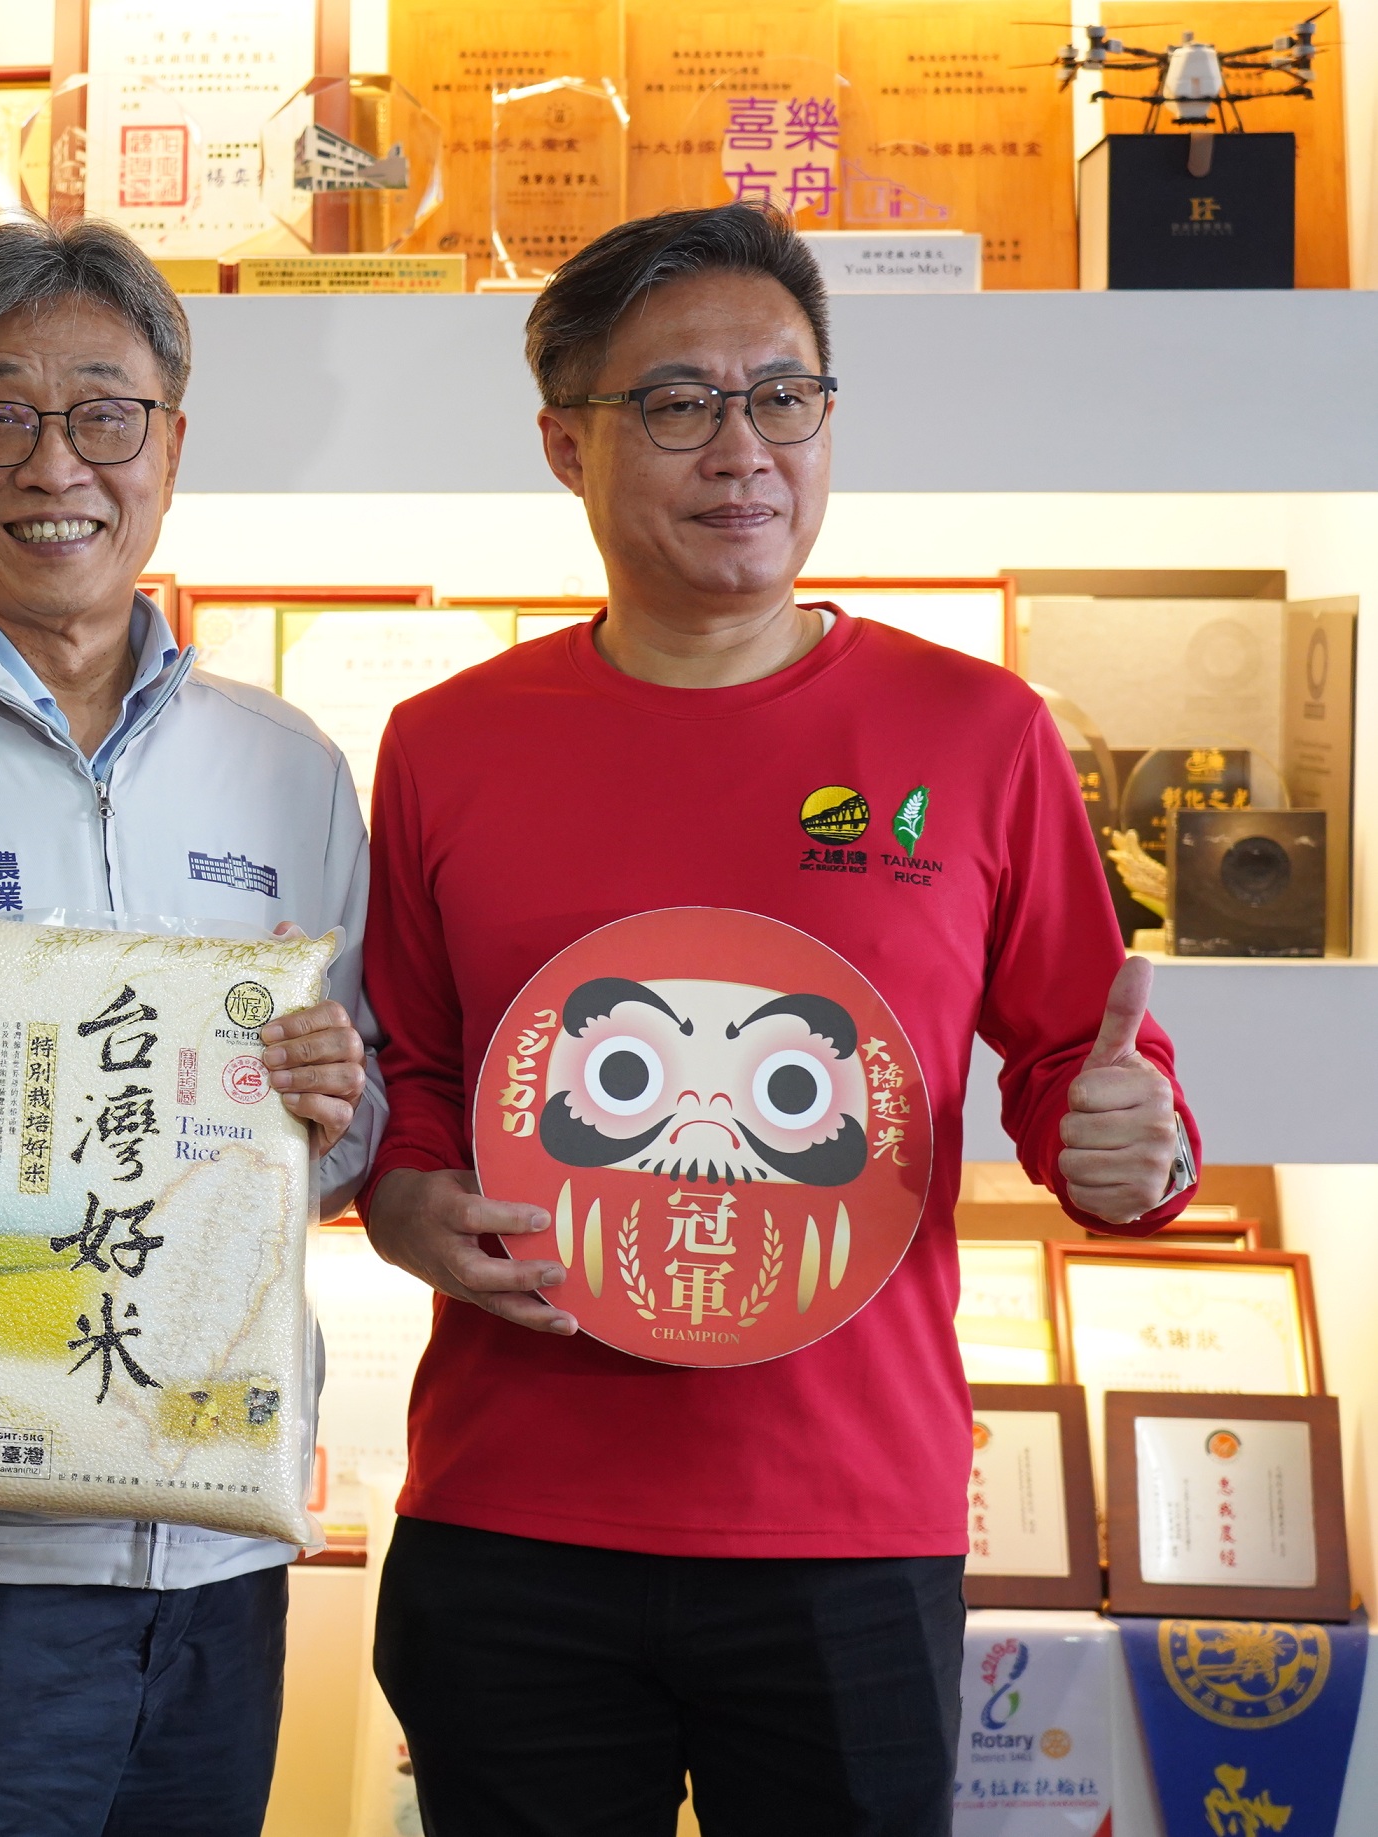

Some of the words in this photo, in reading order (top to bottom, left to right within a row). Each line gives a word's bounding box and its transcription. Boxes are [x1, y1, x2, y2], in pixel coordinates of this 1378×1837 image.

[723, 96, 839, 152] 喜樂
[723, 162, 837, 218] 方舟
[880, 854, 943, 873] TAIWAN
[894, 872, 932, 887] RICE
[214, 1028, 240, 1041] RICE
[496, 1009, 558, 1138] コシヒカリ
[22, 1036, 54, 1185] 特別栽培好米
[860, 1036, 912, 1167] 大橋越光
[175, 1116, 253, 1140] Taiwan
[175, 1140, 221, 1163] Rice
[50, 984, 165, 1405] 台灣好米
[661, 1187, 739, 1326] 冠軍
[650, 1326, 742, 1346] CHAMPION
[981, 1637, 1019, 1686] 42195
[971, 1731, 1034, 1751] Rotary
